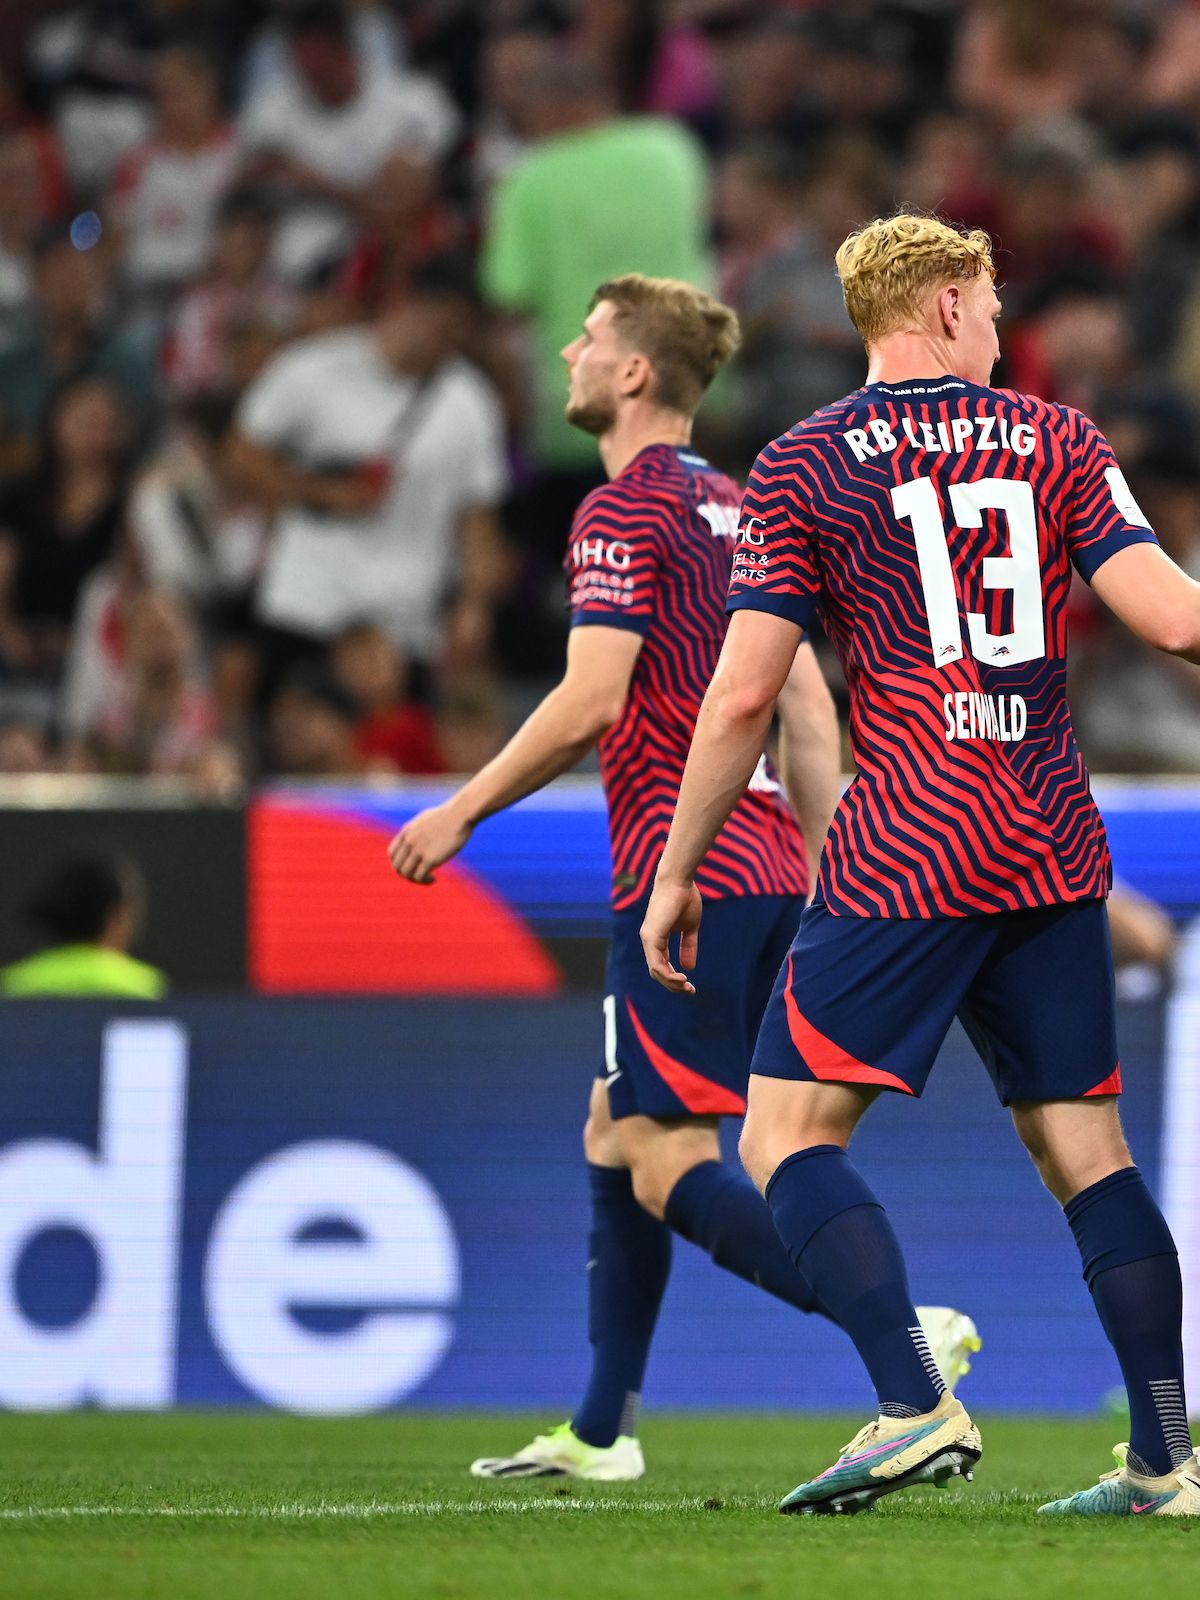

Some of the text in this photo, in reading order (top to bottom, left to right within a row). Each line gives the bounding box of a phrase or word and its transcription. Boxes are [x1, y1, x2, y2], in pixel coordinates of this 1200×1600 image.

[843, 415, 1036, 463] RB LEIPZIG
[572, 538, 634, 572] IHG
[758, 554, 769, 566] &
[890, 476, 1046, 669] 13
[943, 691, 1028, 742] SEIWALD
